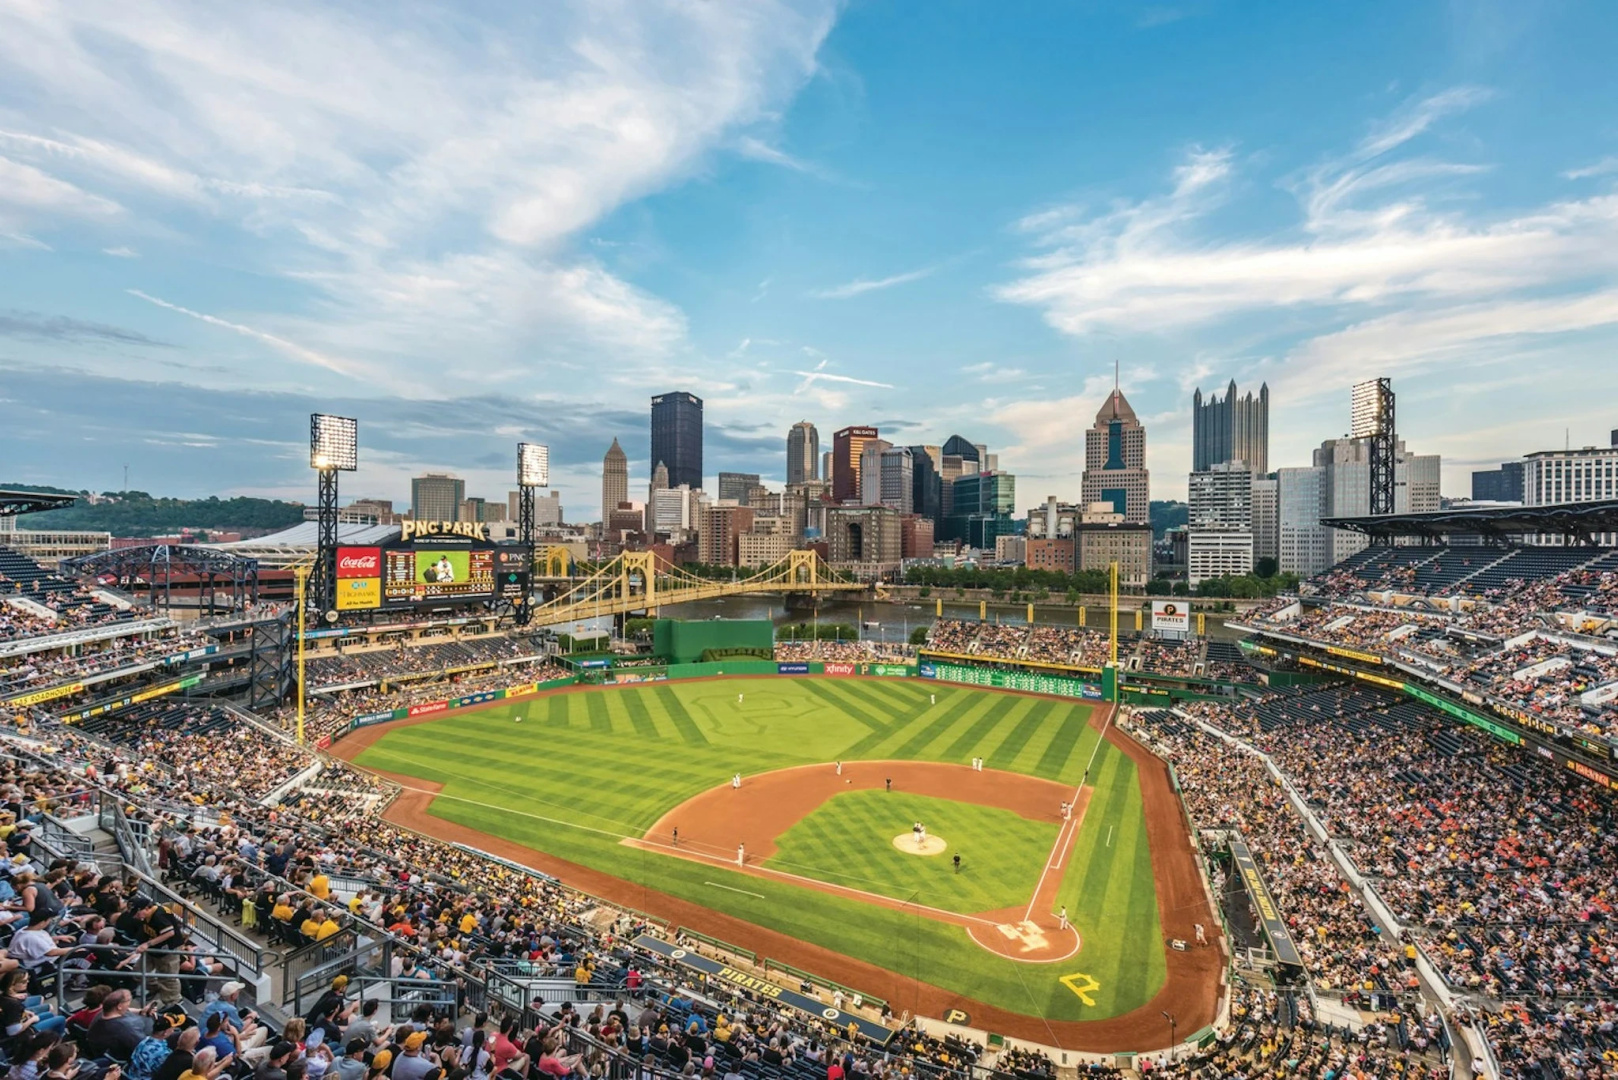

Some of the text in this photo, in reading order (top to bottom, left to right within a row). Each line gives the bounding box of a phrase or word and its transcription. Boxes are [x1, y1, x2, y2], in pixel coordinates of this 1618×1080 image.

[401, 519, 487, 542] PNC PARK
[509, 553, 527, 561] PNC
[826, 664, 854, 674] xfinity
[31, 686, 72, 702] ROADHOUSE
[717, 967, 783, 998] PIRATES
[1059, 972, 1101, 1007] P
[946, 1009, 967, 1024] P
